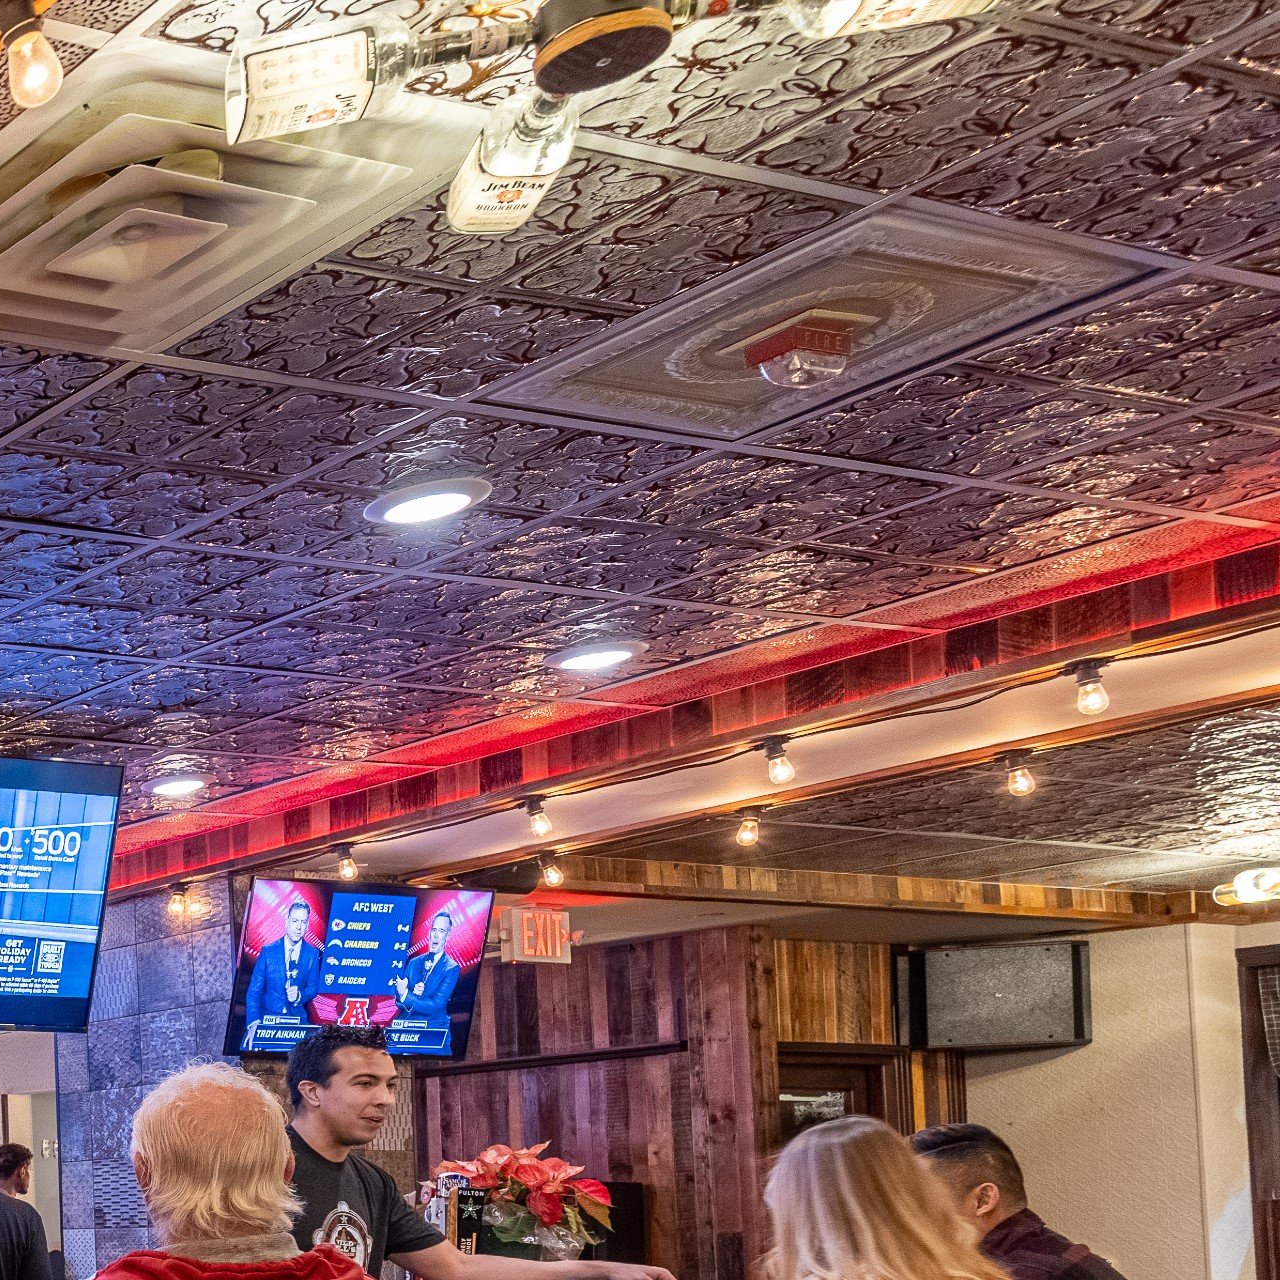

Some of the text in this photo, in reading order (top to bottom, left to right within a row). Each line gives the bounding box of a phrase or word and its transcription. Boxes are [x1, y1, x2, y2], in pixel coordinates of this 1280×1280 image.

[481, 181, 546, 192] JIM BEAM
[476, 203, 529, 211] BOURBON
[805, 332, 842, 350] FIRE
[30, 828, 81, 856] $500
[353, 902, 394, 914] AFC WEST
[347, 922, 371, 931] CHIEFS
[522, 912, 562, 957] EXIT
[5, 939, 23, 948] GET
[344, 940, 379, 949] CHARGERS
[43, 944, 62, 954] BUILT
[341, 958, 403, 968] BRONCOS 7-6
[338, 976, 366, 985] RAIDERS
[256, 1029, 306, 1039] TROY AIKMAN
[400, 1033, 420, 1042] BUCK
